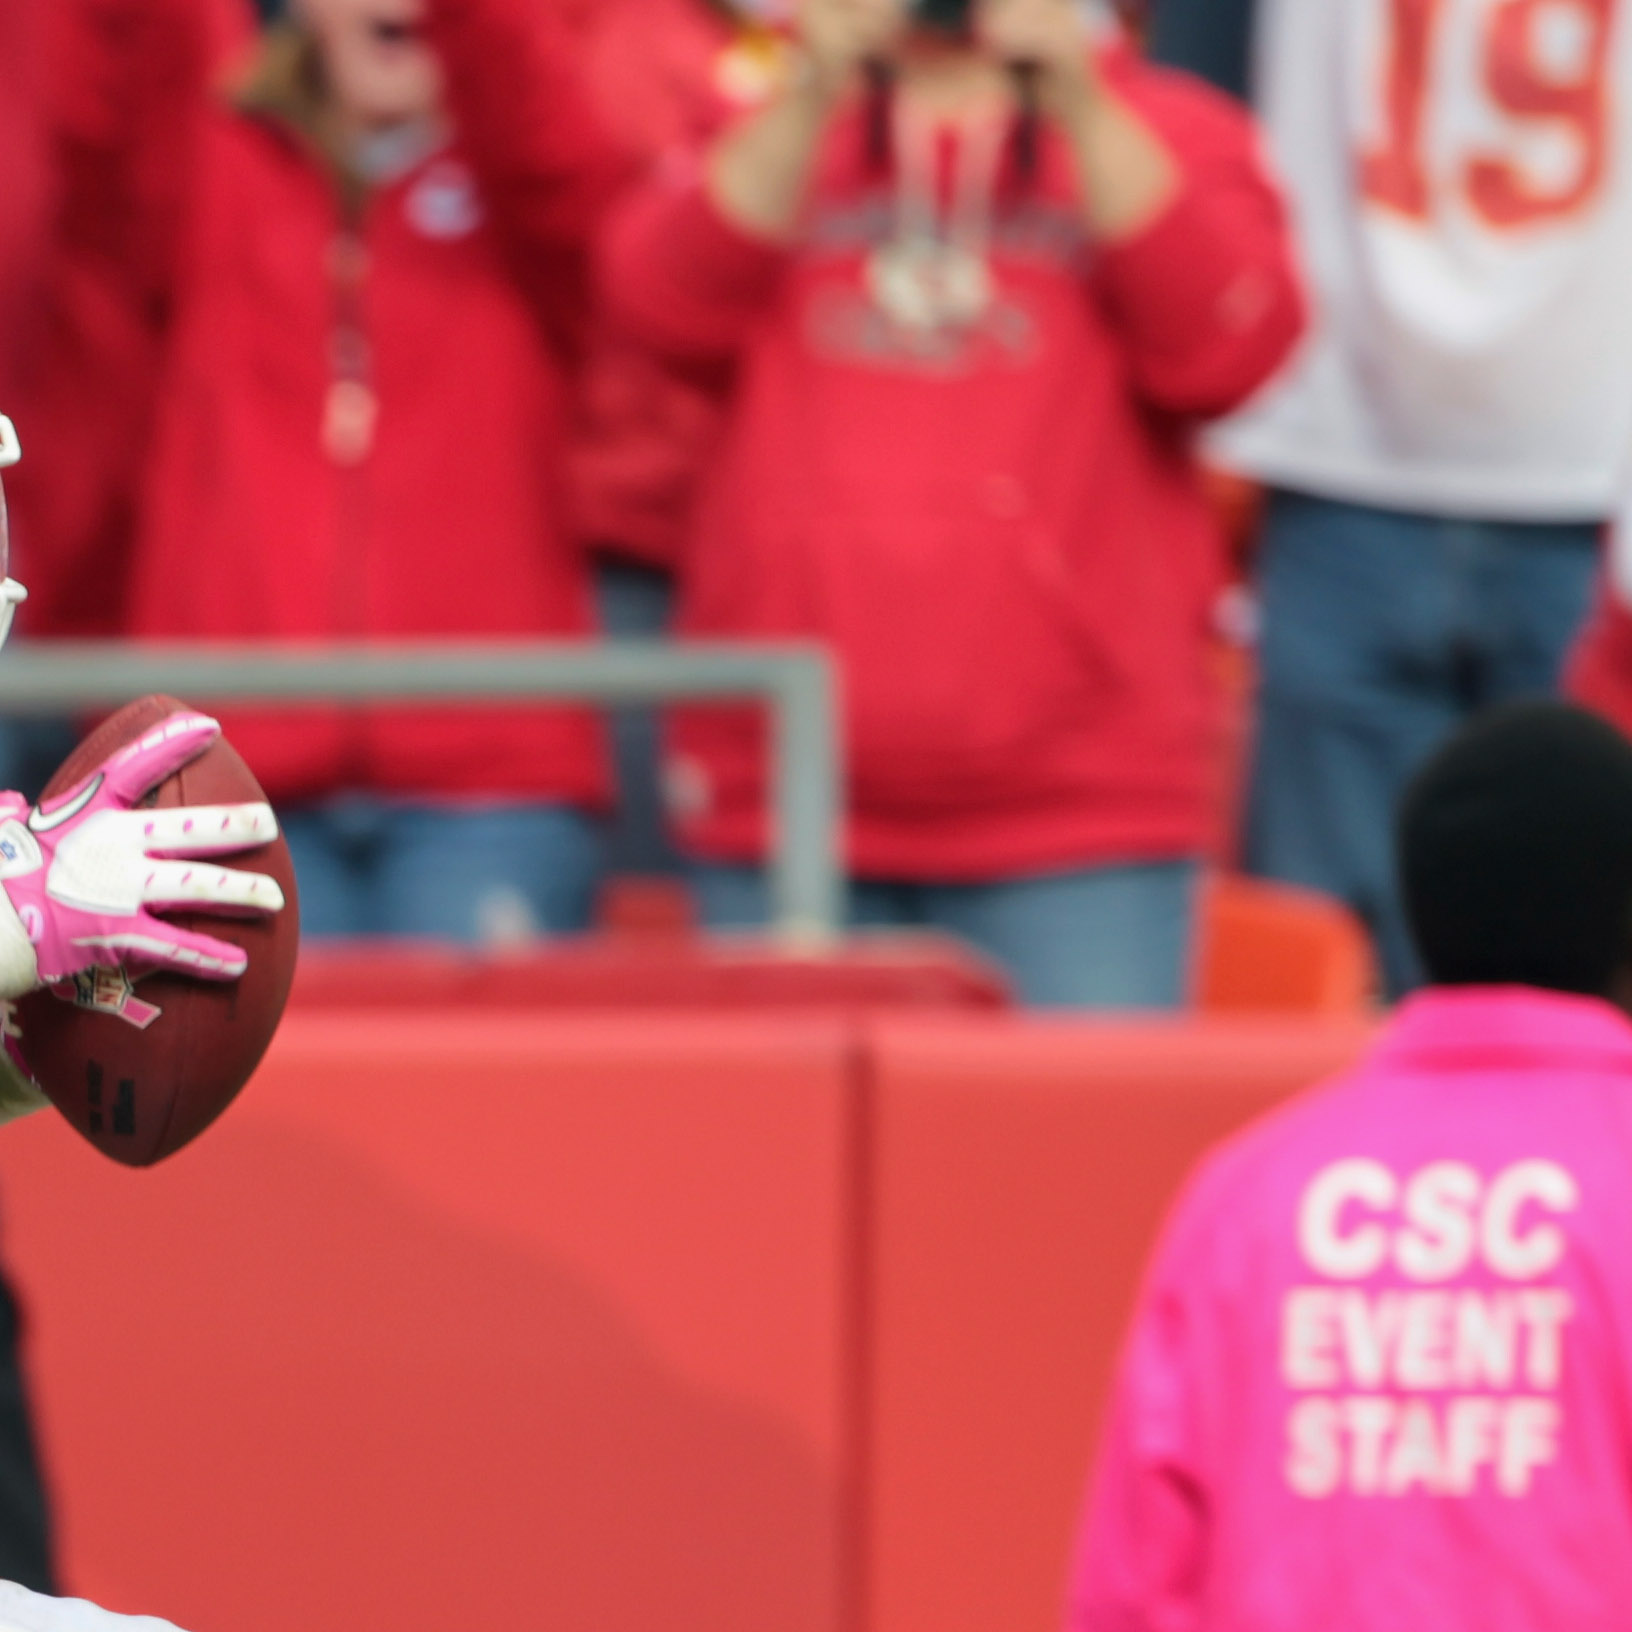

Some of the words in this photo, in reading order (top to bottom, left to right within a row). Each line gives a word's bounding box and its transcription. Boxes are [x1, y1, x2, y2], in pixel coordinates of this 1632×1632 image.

[1297, 1156, 1580, 1282] CSC
[1281, 1284, 1571, 1390] EVENT
[1284, 1394, 1562, 1500] STAFF
